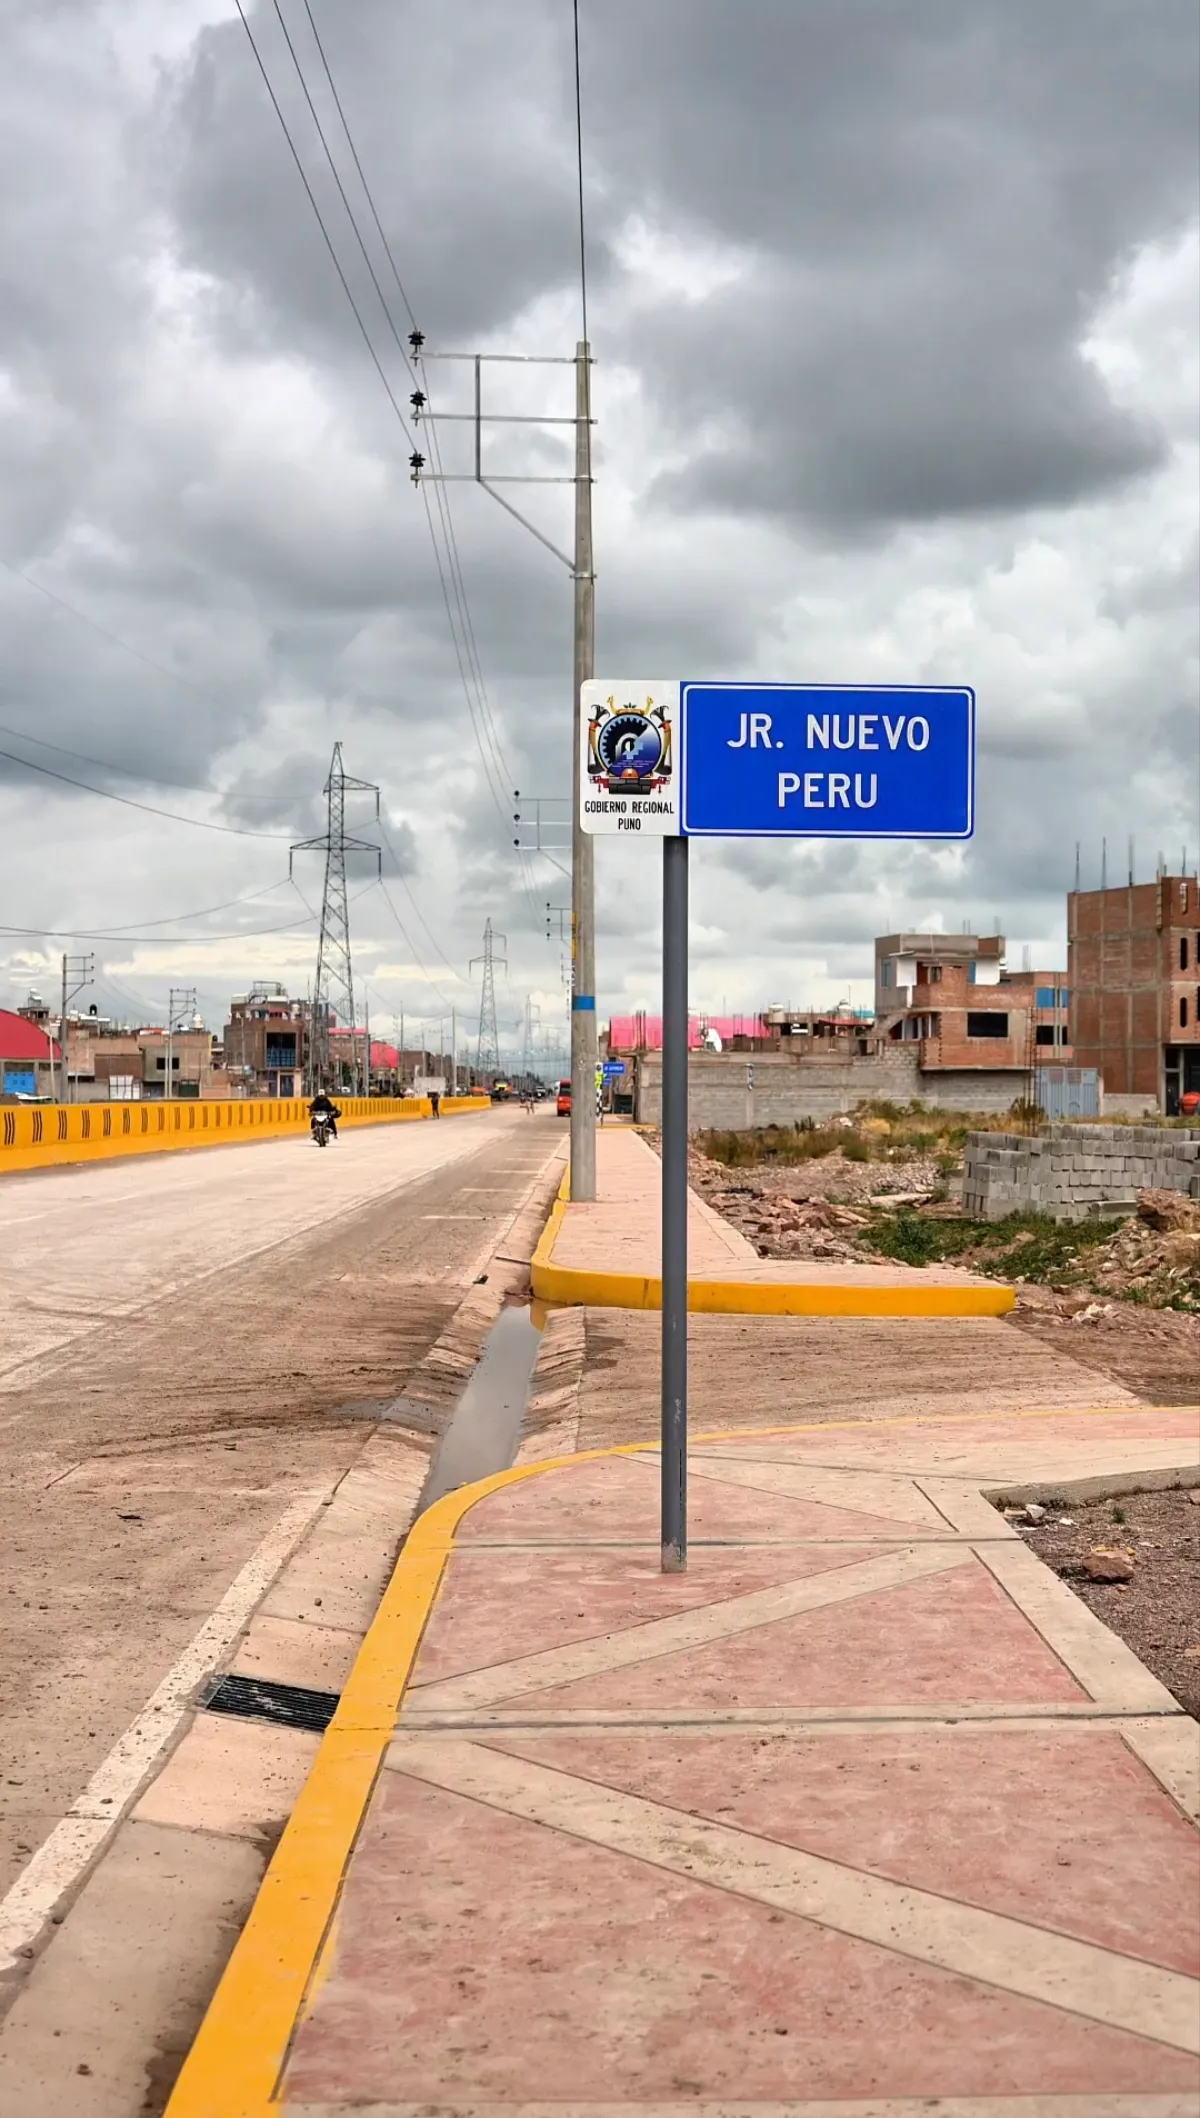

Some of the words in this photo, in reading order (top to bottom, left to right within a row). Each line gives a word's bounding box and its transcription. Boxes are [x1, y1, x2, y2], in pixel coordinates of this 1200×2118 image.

[727, 713, 784, 749] JR.
[807, 713, 930, 751] NUEVO
[778, 772, 878, 808] PERU
[584, 800, 627, 814] GOBIERNO
[632, 801, 675, 814] REGIONAL
[618, 818, 641, 831] PUNO
